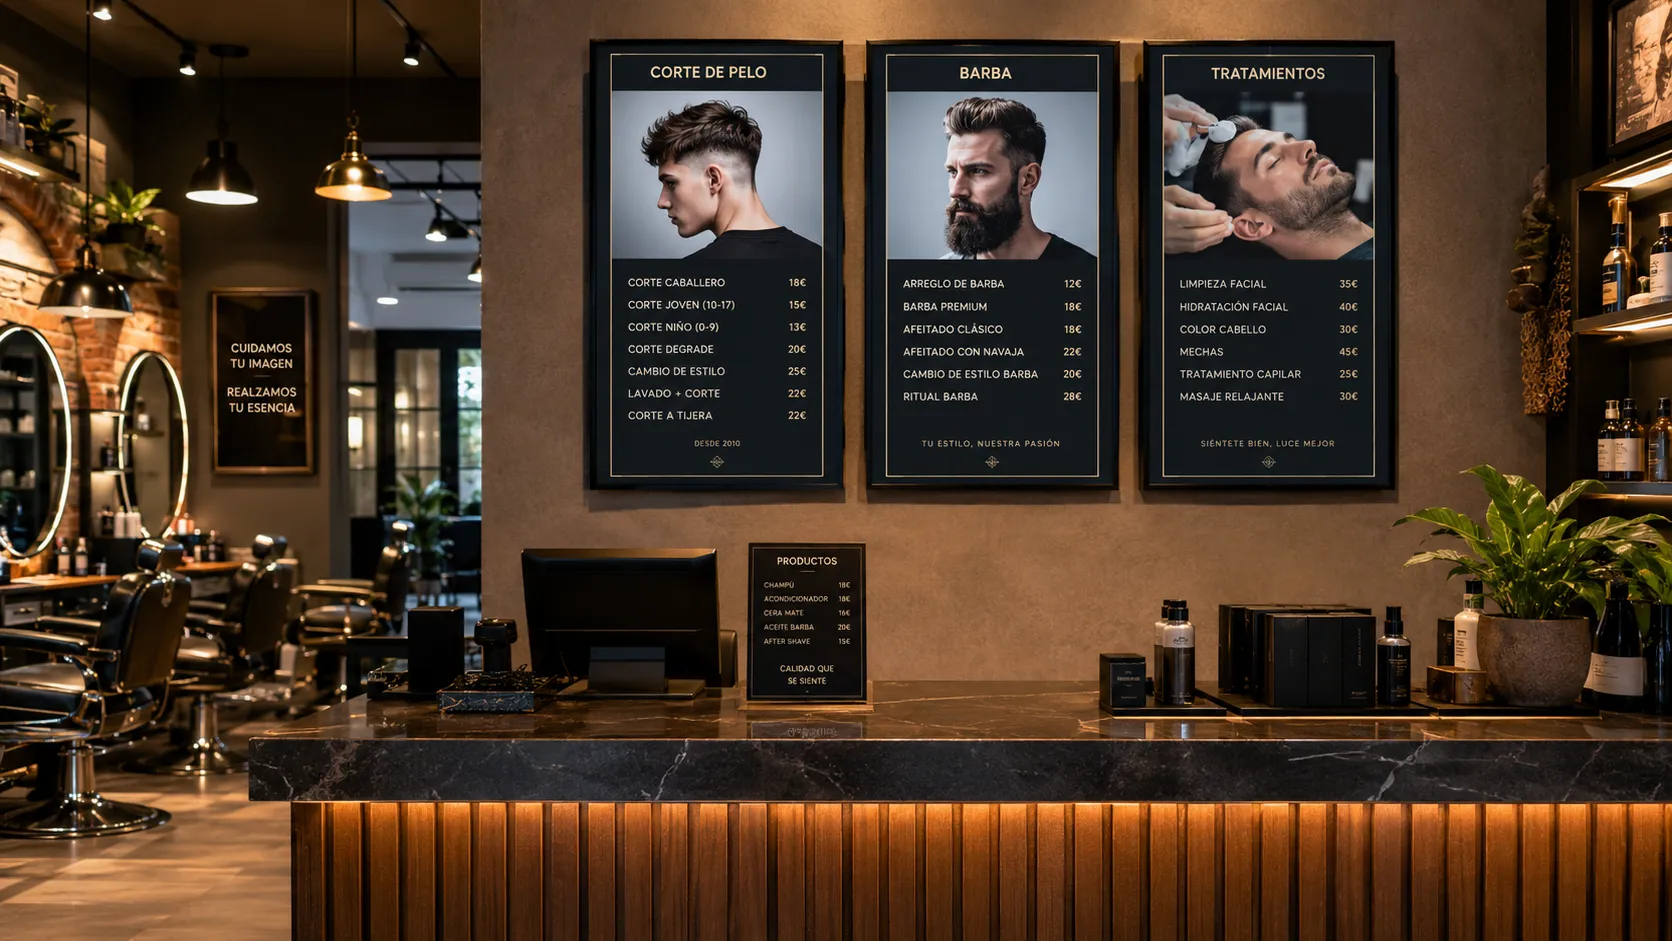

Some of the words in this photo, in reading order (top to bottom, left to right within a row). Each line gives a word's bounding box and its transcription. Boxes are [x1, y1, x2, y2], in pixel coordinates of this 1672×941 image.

[650, 65, 701, 79] CORTE
[705, 65, 725, 79] DE
[728, 65, 767, 79] PELO
[959, 66, 1013, 80] BARBA
[1210, 67, 1326, 80] TRATAMIENTOS
[627, 277, 663, 288] CORTE
[665, 277, 726, 288] CABALLERO
[788, 277, 807, 288] 18€
[902, 279, 951, 289] ARREGLO
[953, 279, 968, 289] DE
[970, 279, 1005, 289] BARBA
[1064, 279, 1082, 289] 12€
[1179, 279, 1228, 289] LIMPIEZA
[1230, 279, 1267, 289] FACIAL
[1339, 279, 1358, 289] 35€
[627, 300, 663, 311] CORTE
[665, 300, 700, 311] JOVEN
[703, 299, 736, 312] (10-17)
[788, 300, 807, 311] 15€
[903, 301, 938, 312] BARBA
[940, 301, 988, 312] PREMIUM
[1064, 301, 1082, 312] 18€
[1179, 300, 1250, 312] HIDRATACIÓN
[1252, 302, 1289, 312] FACIAL
[1339, 302, 1358, 312] 40€
[627, 322, 663, 333] CORTE
[665, 320, 694, 333] NIÑO
[696, 321, 720, 333] (0-9)
[788, 322, 807, 333] 13€
[902, 324, 955, 335] AFEITADO
[956, 322, 1004, 335] CLÁSICO
[1064, 324, 1082, 335] 18€
[1179, 324, 1216, 335] COLOR
[1218, 324, 1267, 335] CABELLO
[1339, 324, 1358, 335] 30€
[230, 342, 293, 354] CUIDAMOS
[627, 344, 663, 354] CORTE
[665, 344, 714, 354] DEGRADE
[788, 344, 807, 354] 20€
[902, 347, 955, 357] AFEITADO
[956, 347, 981, 357] CON
[983, 347, 1025, 357] NAVAJA
[1063, 347, 1082, 357] 22€
[1179, 347, 1224, 357] MECHAS
[1339, 347, 1358, 357] 45€
[230, 358, 246, 369] TU
[248, 358, 294, 369] IMAGEN
[627, 366, 671, 376] CAMBIO
[673, 366, 687, 376] DE
[689, 366, 726, 376] ESTILO
[788, 366, 807, 376] 25€
[902, 369, 946, 379] CAMBIO
[948, 369, 962, 379] DE
[964, 369, 1001, 379] ESTILO
[1003, 369, 1039, 379] BARBA
[1063, 369, 1082, 379] 20€
[1179, 369, 1254, 379] TRATAMIENTO
[1256, 369, 1302, 379] CAPILAR
[1339, 369, 1358, 379] 25€
[227, 386, 297, 398] REALZAMOS
[627, 388, 672, 399] LAVADO
[675, 390, 682, 398] +
[684, 388, 721, 399] CORTE
[788, 388, 807, 399] 22€
[903, 391, 941, 402] RITUAL
[943, 391, 979, 402] BARBA
[1063, 391, 1082, 402] 28€
[1179, 391, 1222, 402] MASAJE
[1224, 391, 1284, 402] RELAJANTE
[1339, 391, 1358, 402] 30€
[228, 402, 244, 413] TU
[247, 402, 296, 413] ESENCIA
[627, 410, 663, 421] CORTE
[666, 410, 675, 421] A
[677, 410, 713, 421] TIJERA
[788, 410, 807, 421] 22€
[694, 439, 721, 447] DESDE
[722, 439, 741, 447] 2010
[921, 439, 934, 448] TU
[937, 439, 974, 449] ESTILO,
[977, 439, 1021, 448] NUESTRA
[1024, 438, 1060, 448] PASIÓN
[1200, 438, 1244, 448] SIÉNTETE
[1247, 439, 1273, 449] BIEN,
[1275, 439, 1300, 448] LUCE
[1303, 439, 1335, 448] MEJOR
[777, 556, 838, 566] PRODUCTOS
[838, 581, 851, 589] 18€
[763, 595, 829, 603] ACONDICIONADOR
[838, 595, 851, 603] 18€
[763, 609, 783, 617] CERA
[784, 609, 804, 617] MATE
[838, 609, 851, 617] 16€
[763, 623, 789, 631] ACEITE
[790, 623, 815, 631] BARBA
[837, 623, 851, 631] 20€
[763, 637, 786, 645] AFTER
[787, 637, 811, 645] SHAVE
[838, 637, 851, 645] 15€
[779, 664, 816, 673] CALIDAD
[817, 664, 834, 674] QUE
[787, 676, 797, 685] SE
[799, 676, 827, 685] SIENTE
